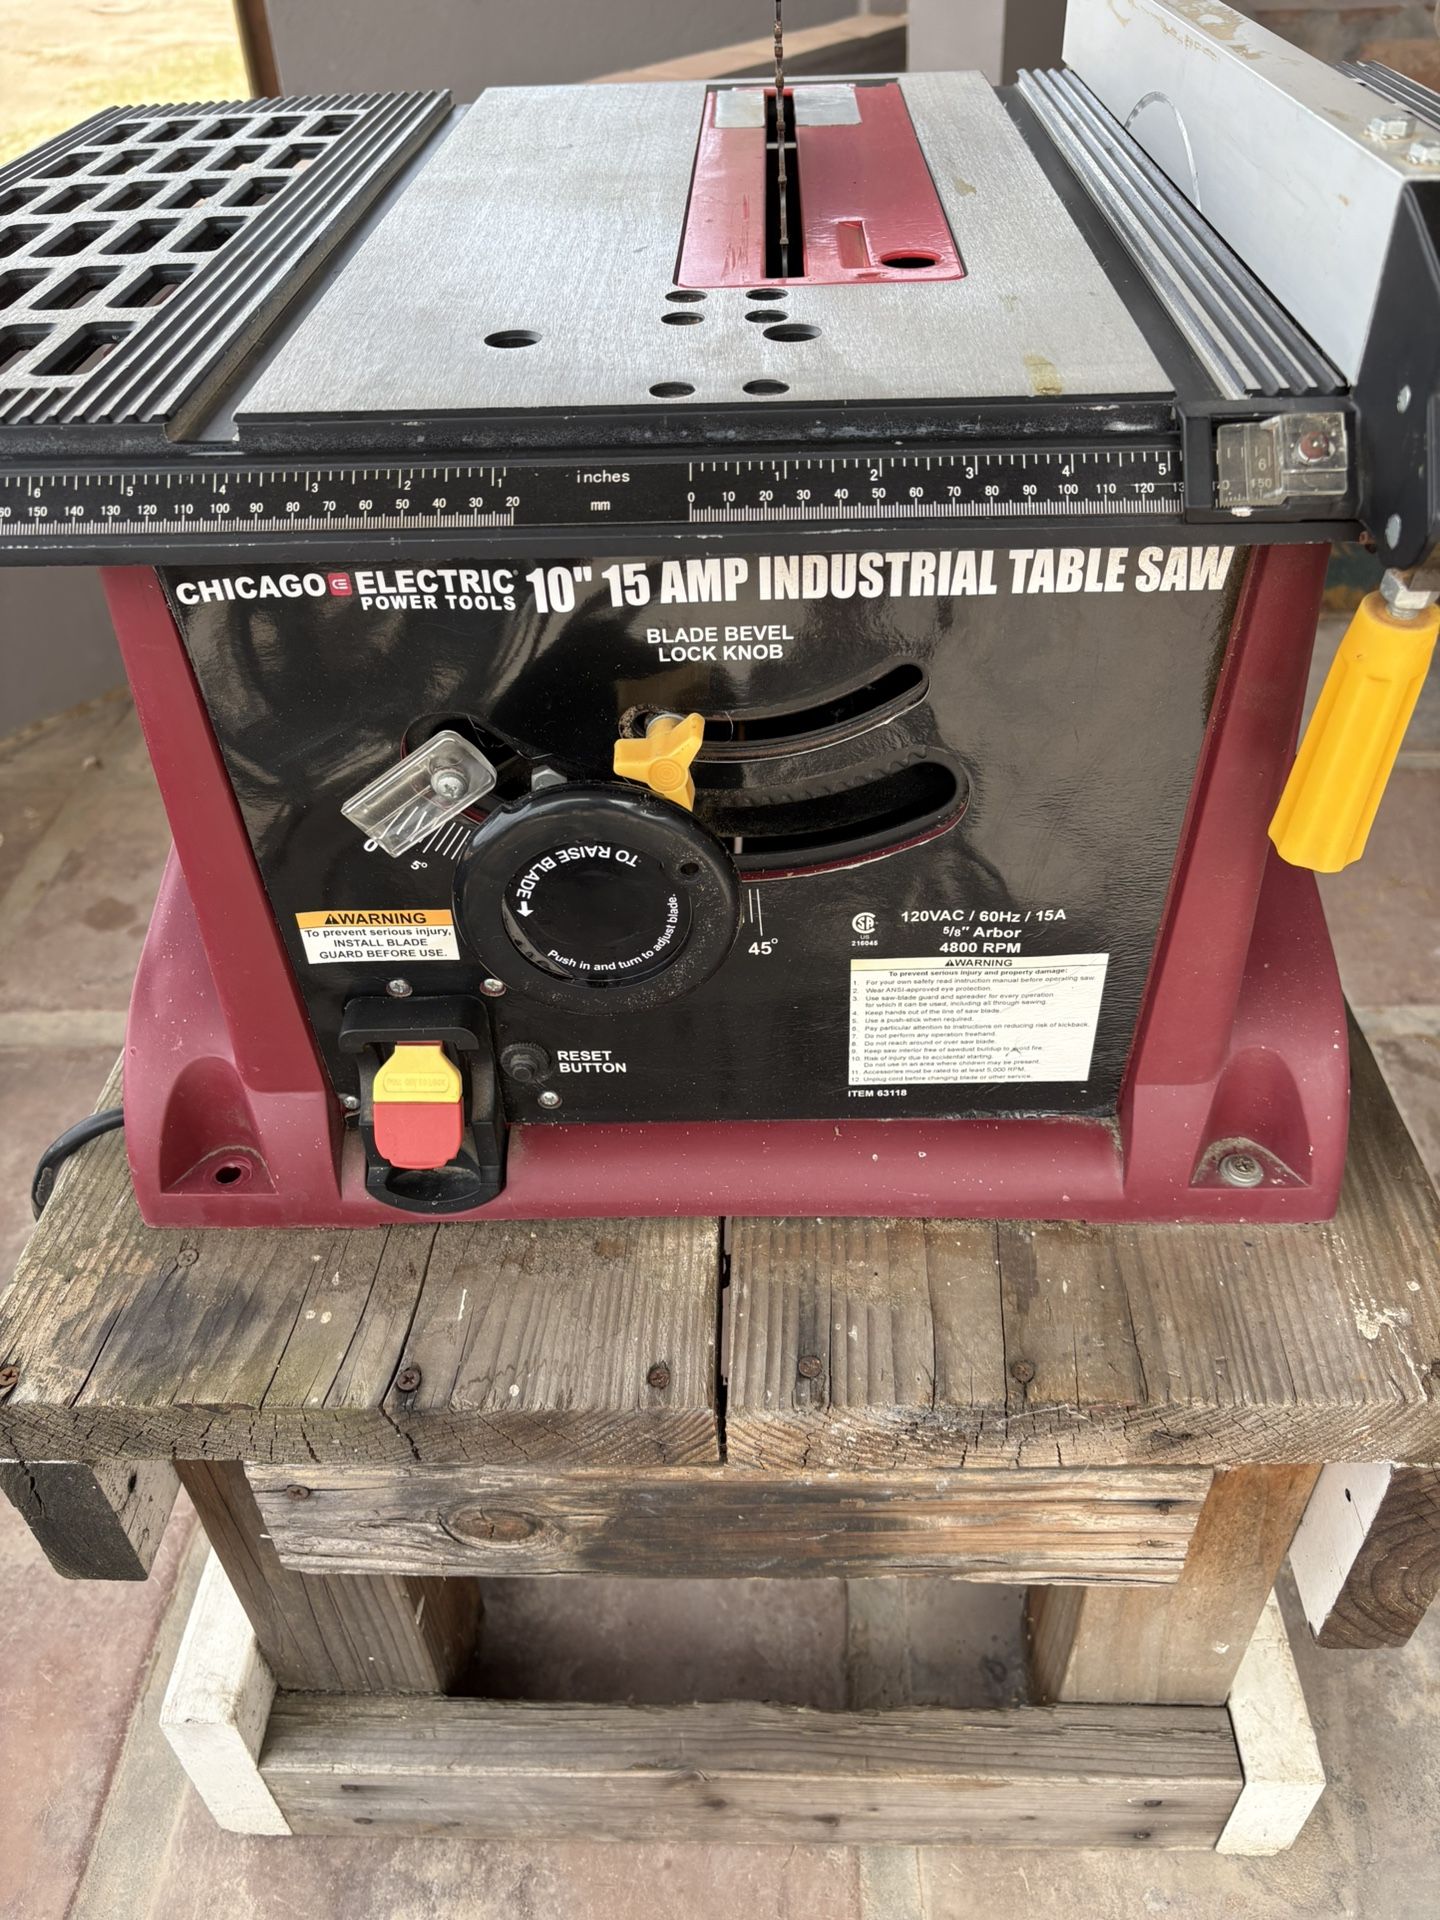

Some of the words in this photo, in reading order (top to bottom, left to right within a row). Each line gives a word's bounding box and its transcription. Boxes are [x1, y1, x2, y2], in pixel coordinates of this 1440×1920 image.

[33, 488, 41, 498] 6
[126, 486, 134, 496] 5
[218, 484, 226, 494] 4
[311, 483, 319, 493] 3
[404, 481, 411, 490] 2
[497, 478, 502, 488] 1
[576, 470, 630, 484] inches
[774, 472, 780, 482] 1
[870, 470, 878, 481] 2
[966, 468, 974, 479] 3
[1062, 465, 1070, 476] 4
[1158, 463, 1166, 476] 5
[0, 506, 11, 518] 60
[28, 506, 48, 517] 150
[64, 506, 84, 516] 140
[101, 505, 121, 516] 130
[137, 504, 157, 515] 120
[174, 504, 194, 514] 110
[210, 502, 230, 515] 100
[250, 502, 264, 514] 90
[286, 501, 300, 512] 80
[323, 500, 336, 512] 70
[359, 499, 373, 511] 60
[396, 498, 410, 510] 50
[432, 498, 446, 509] 40
[469, 497, 483, 508] 30
[506, 496, 520, 507] 20
[591, 499, 610, 511] mm
[688, 492, 695, 502] 0
[722, 492, 736, 502] 10
[760, 490, 774, 500] 20
[796, 490, 811, 500] 30
[834, 489, 848, 500] 40
[872, 488, 886, 499] 50
[909, 487, 923, 498] 60
[948, 486, 961, 497] 70
[985, 486, 999, 496] 80
[1023, 484, 1037, 496] 90
[1058, 484, 1078, 495] 100
[1096, 484, 1116, 494] 110
[1134, 482, 1154, 494] 120
[1173, 482, 1184, 493] 13
[526, 566, 592, 614] 10"
[602, 563, 651, 608] 15
[660, 558, 748, 604] AMP
[758, 550, 998, 600] INDUSTRIAL
[1009, 548, 1129, 594] TABLE
[1135, 546, 1234, 592] SAW
[176, 572, 326, 606] CHICAGO
[360, 596, 438, 610] POWER
[449, 595, 516, 610] TOOLS
[646, 626, 718, 644] BLADE
[724, 624, 794, 642] BEVEL
[658, 646, 716, 662] LOCK
[722, 644, 784, 660] KNOB
[556, 845, 611, 863] RAISE
[615, 850, 638, 867] TO
[516, 856, 557, 900] BLADE
[338, 912, 426, 924] WARNING
[902, 910, 964, 922] 120VAC
[969, 910, 975, 922] /
[979, 910, 1021, 923] 60Hz
[1024, 911, 1031, 922] /
[1036, 909, 1066, 922] 15A
[304, 930, 319, 938] To
[323, 929, 366, 938] prevent
[416, 928, 452, 938] injury,
[548, 950, 576, 968] Push
[579, 961, 590, 970] in
[594, 962, 616, 971] and
[618, 956, 642, 969] turn
[641, 950, 654, 960] to
[653, 924, 676, 952] adjust
[667, 894, 678, 924] blade.
[972, 926, 1022, 938] Arbor
[334, 939, 384, 947] INSTALL
[387, 938, 428, 946] BLADE
[748, 938, 778, 956] 45°
[940, 942, 978, 954] 4800
[982, 942, 1022, 954] RPM
[320, 950, 363, 959] GUARD
[367, 950, 416, 958] BEFORE
[420, 949, 448, 957] USE.
[955, 959, 1013, 967] WARNING
[557, 1050, 612, 1062] RESET
[558, 1062, 628, 1073] BUTTON
[876, 1088, 908, 1097] 63118
